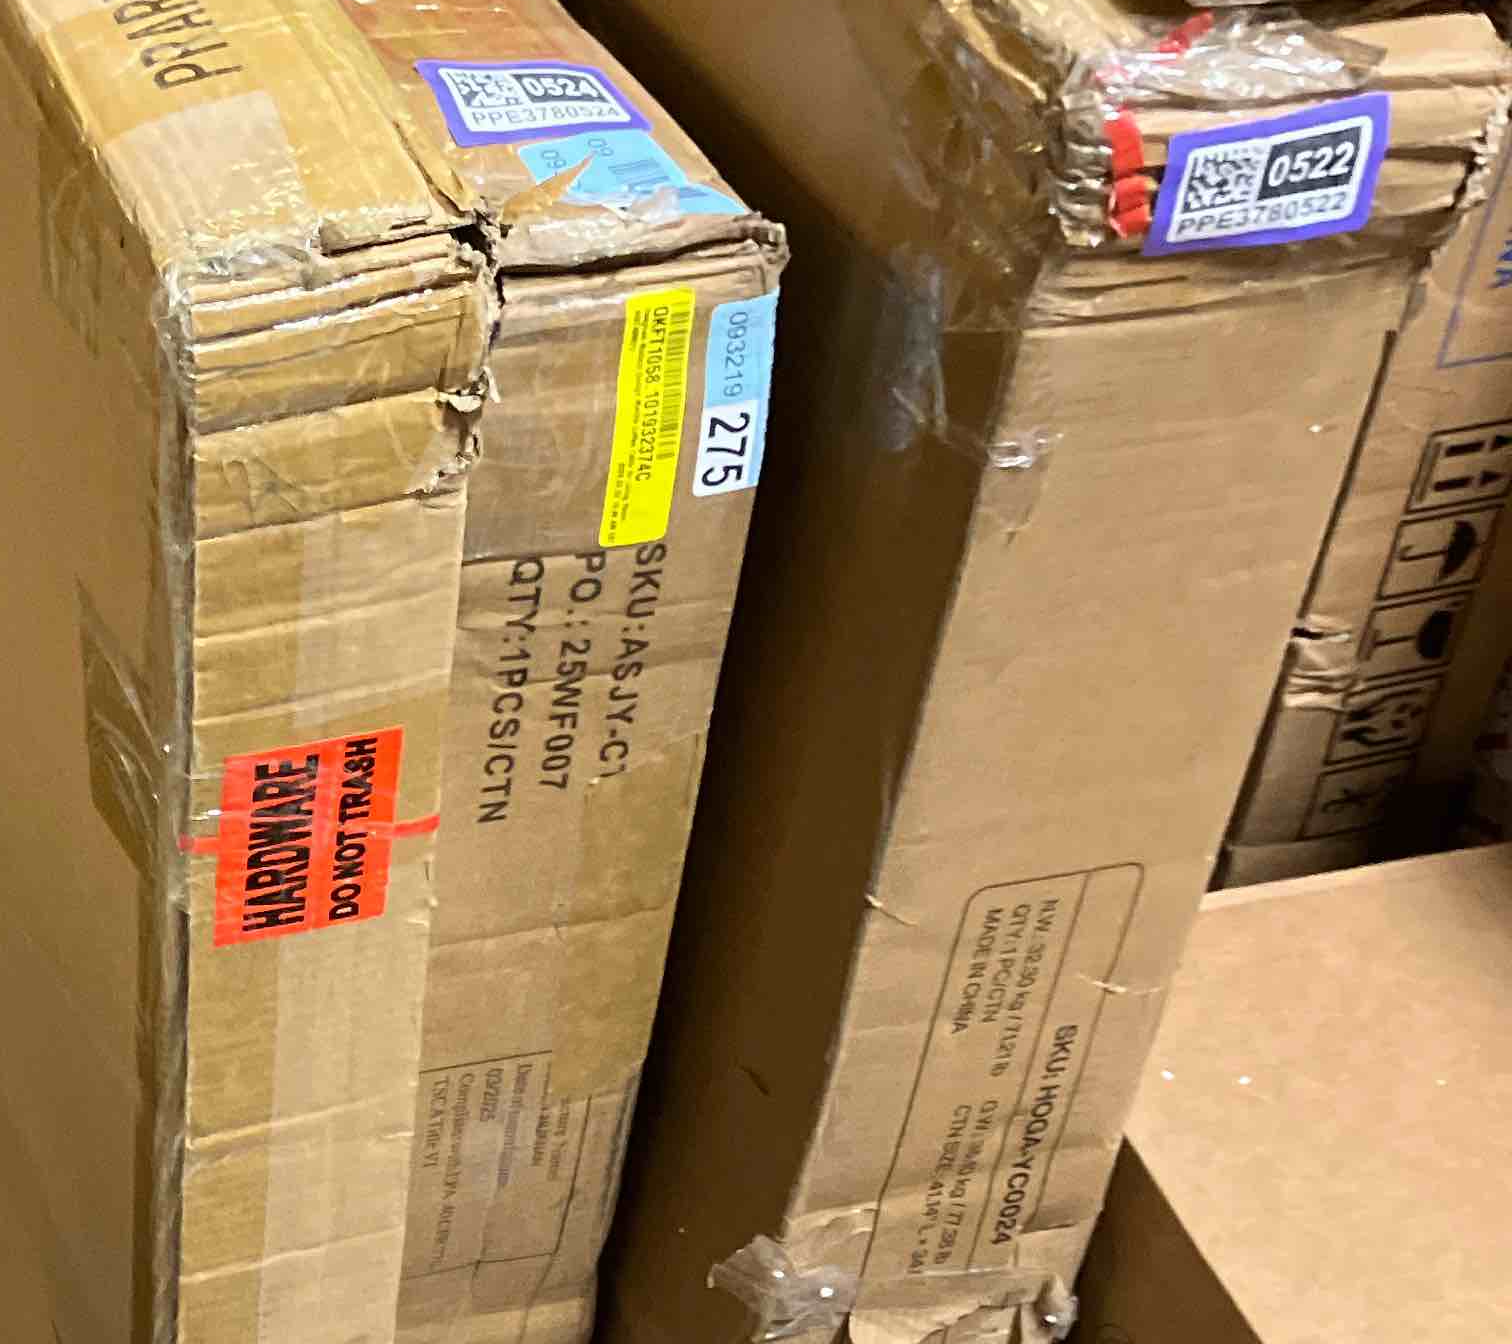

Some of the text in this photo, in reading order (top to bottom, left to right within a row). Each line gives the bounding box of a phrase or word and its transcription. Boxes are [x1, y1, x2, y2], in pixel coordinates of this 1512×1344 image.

[525, 73, 599, 102] 0524
[471, 104, 621, 126] PPE3780524
[1268, 141, 1356, 187] 0522
[1175, 190, 1348, 236] PPE3780522
[723, 312, 748, 397] 093219
[702, 412, 751, 486] 275
[242, 754, 320, 931] HARDWARE
[329, 737, 378, 920] DO NOT TRASH
[973, 908, 1003, 960] MADE
